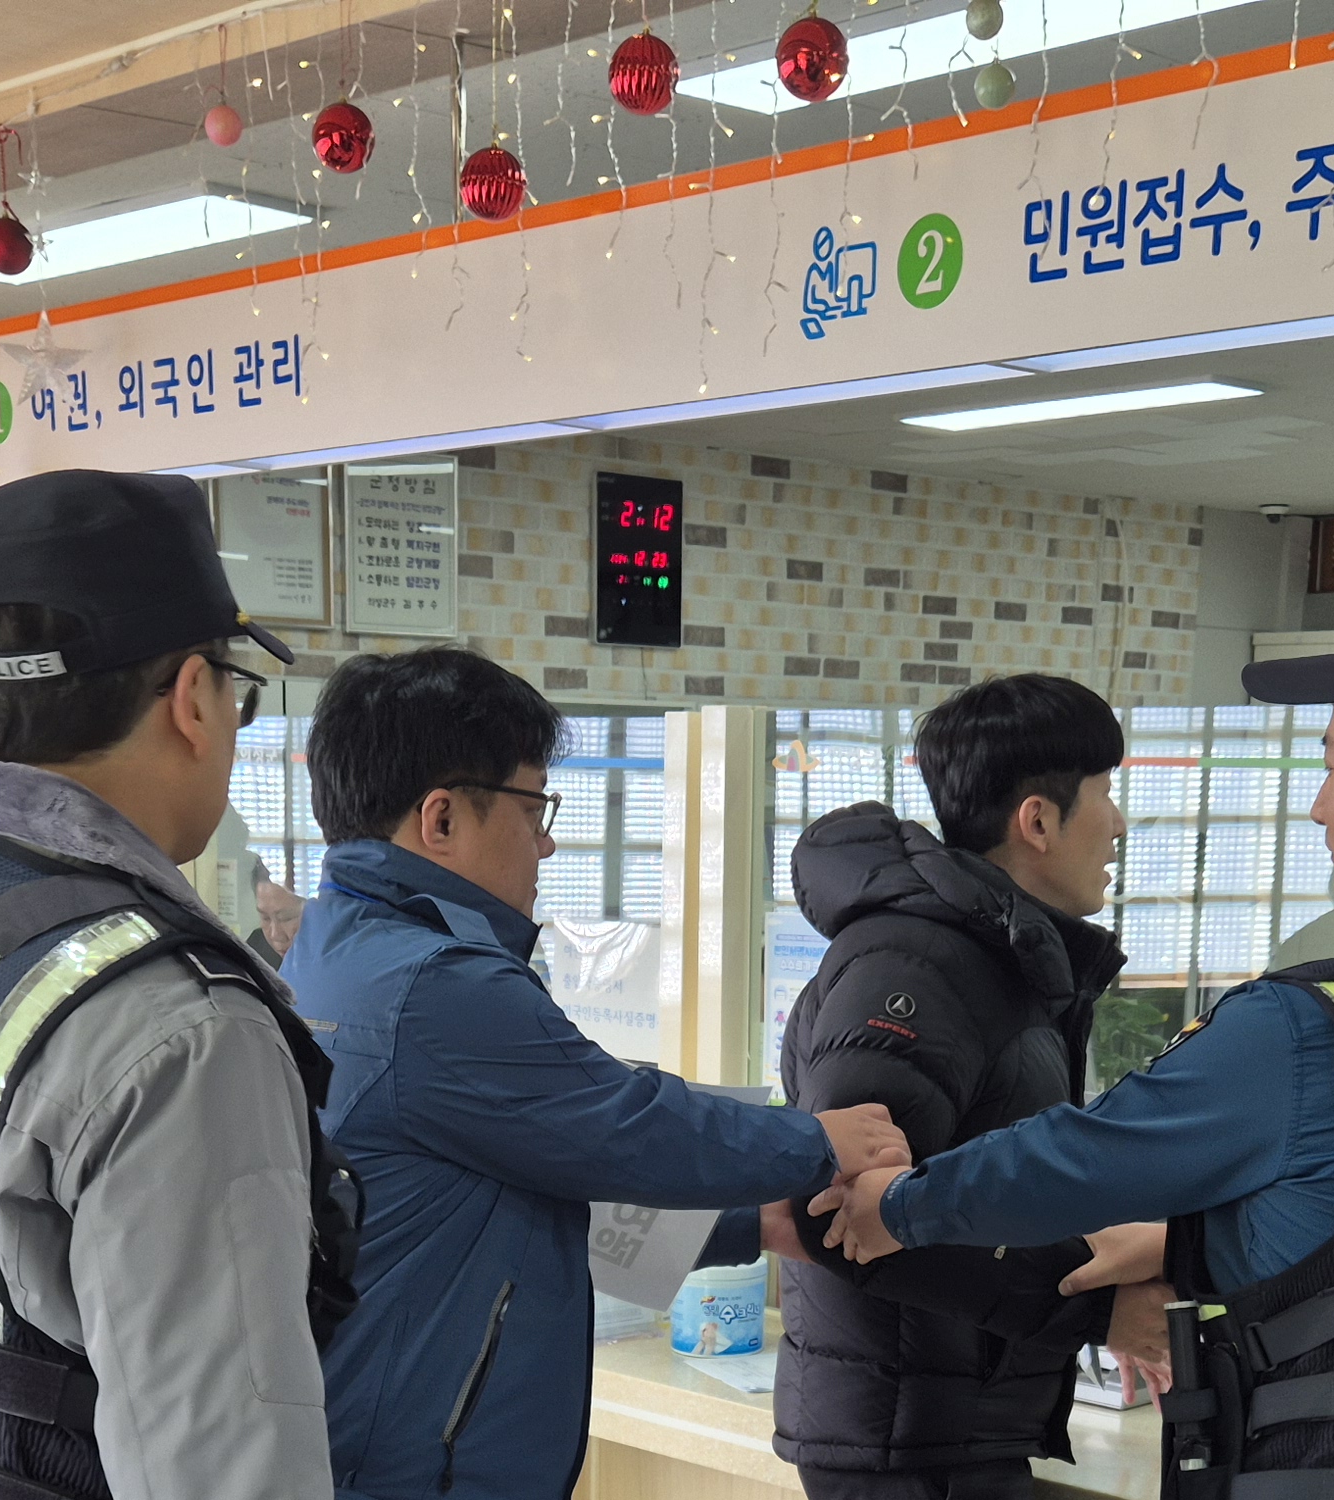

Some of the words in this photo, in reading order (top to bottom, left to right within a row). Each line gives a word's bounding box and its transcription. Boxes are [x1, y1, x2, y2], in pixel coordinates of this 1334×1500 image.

[1022, 162, 1264, 285] 민원접수,
[118, 348, 215, 418] 외국인
[233, 333, 301, 407] 관리
